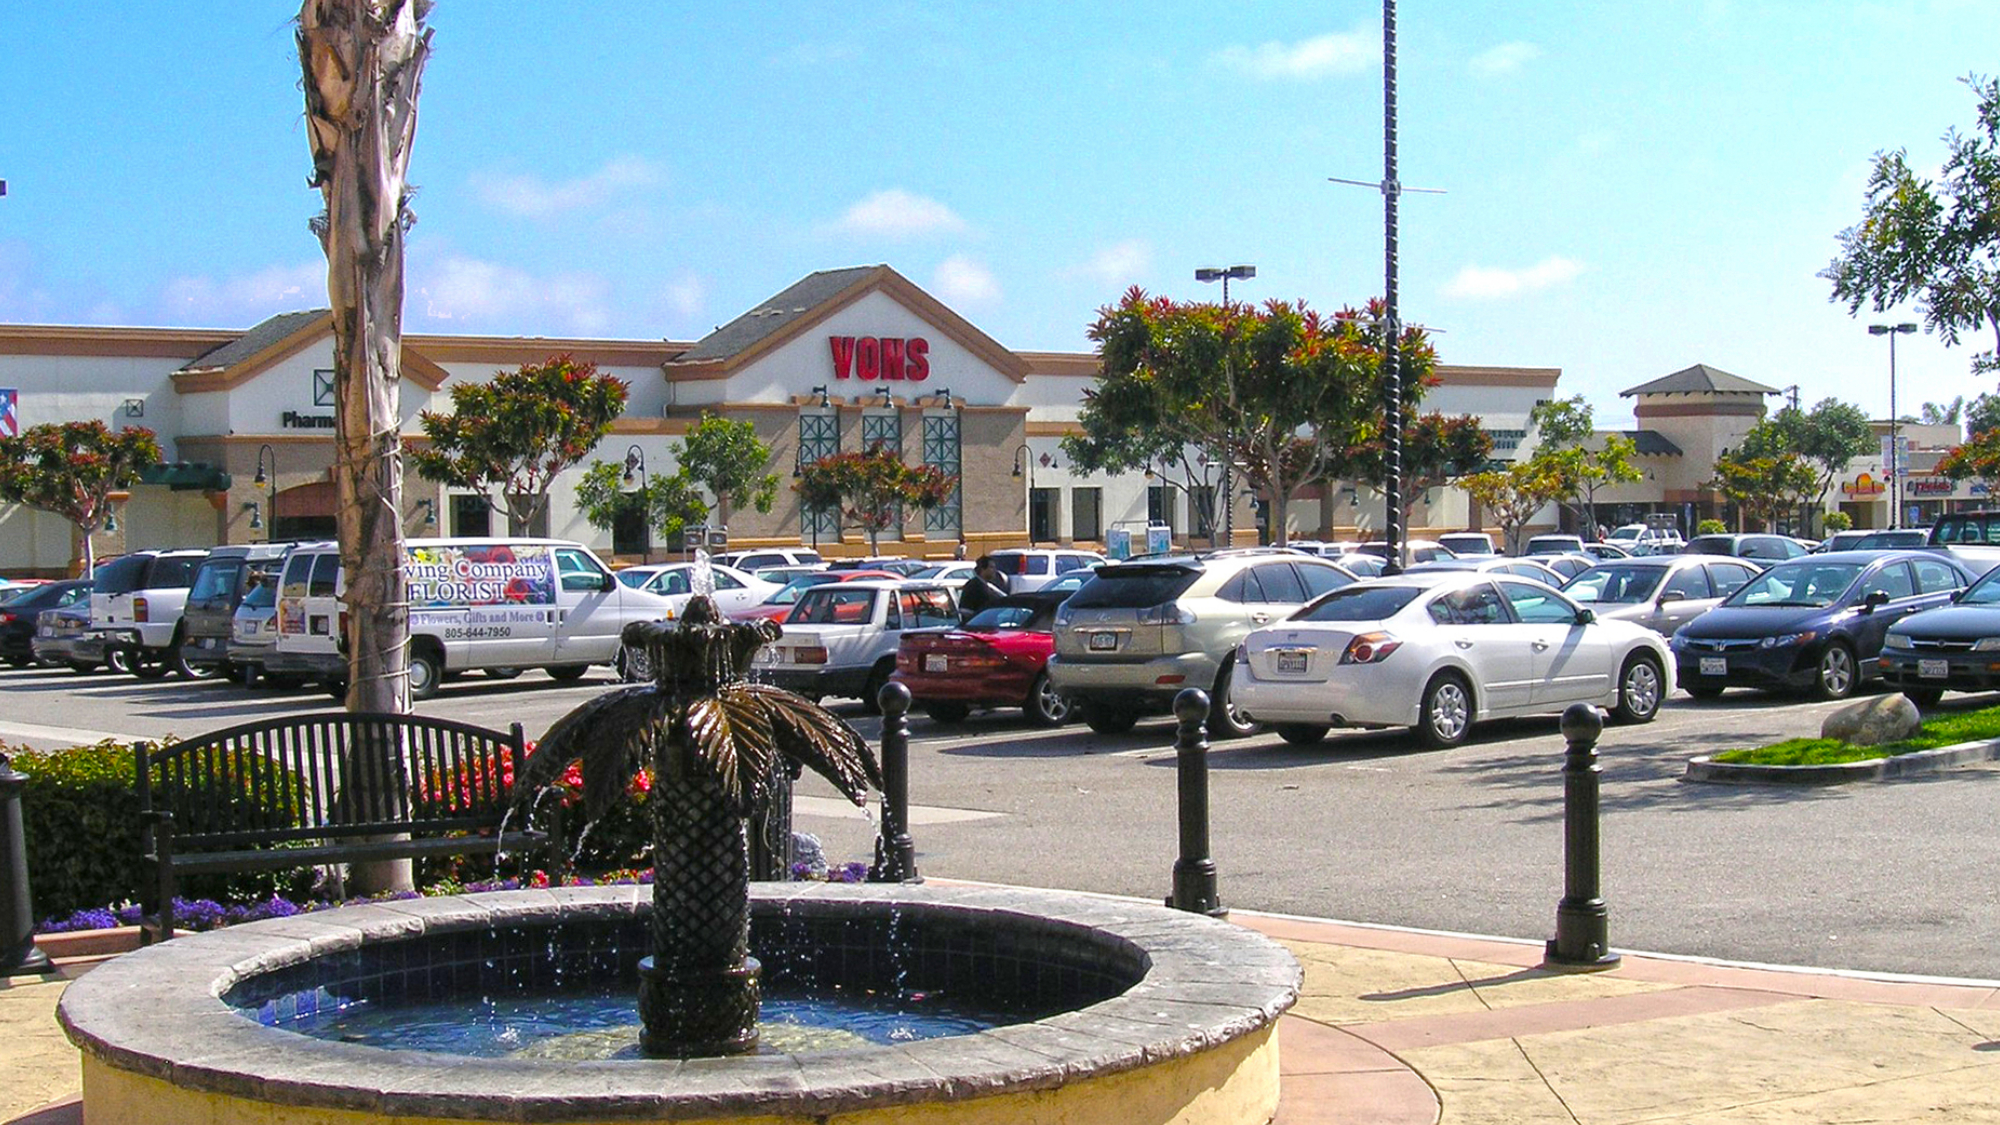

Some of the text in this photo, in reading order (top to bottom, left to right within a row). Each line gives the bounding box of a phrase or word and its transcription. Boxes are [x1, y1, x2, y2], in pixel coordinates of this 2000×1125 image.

[829, 336, 929, 381] VONS
[283, 411, 335, 428] Pharm
[455, 560, 547, 582] Company
[410, 582, 506, 600] FLORIST
[420, 611, 534, 625] Flowers, Gifts and More
[445, 627, 511, 638] 805-644-7950
